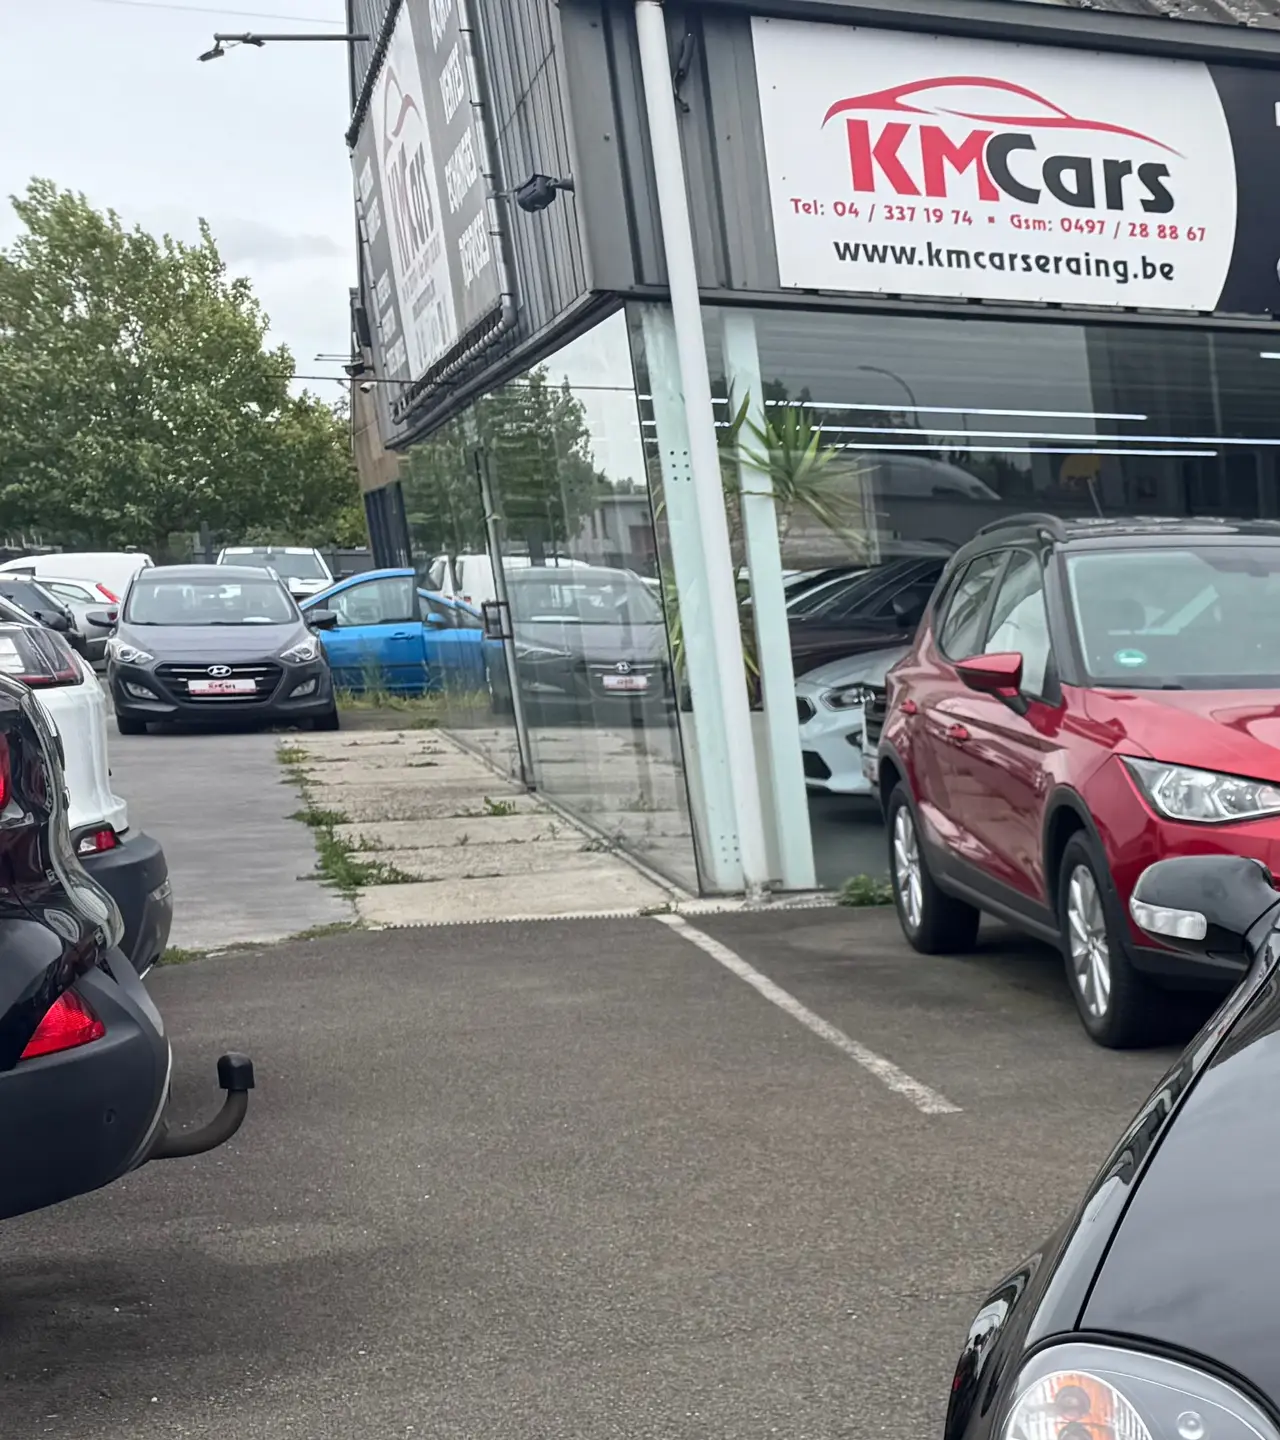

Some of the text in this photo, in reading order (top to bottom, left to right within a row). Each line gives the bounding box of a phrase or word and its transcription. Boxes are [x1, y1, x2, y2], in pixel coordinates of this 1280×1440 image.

[846, 119, 1175, 214] KMCars
[790, 198, 825, 216] Tel:
[833, 201, 860, 219] 04
[884, 205, 916, 223] 337
[924, 207, 944, 225] 19
[951, 209, 973, 226] 74
[1010, 214, 1053, 233] Gsm:
[1061, 217, 1106, 236] 0497
[1128, 222, 1149, 239] 28
[1157, 223, 1179, 240] 88
[1186, 225, 1206, 242] 67
[833, 240, 1175, 284] www.kmcarseraing.be
